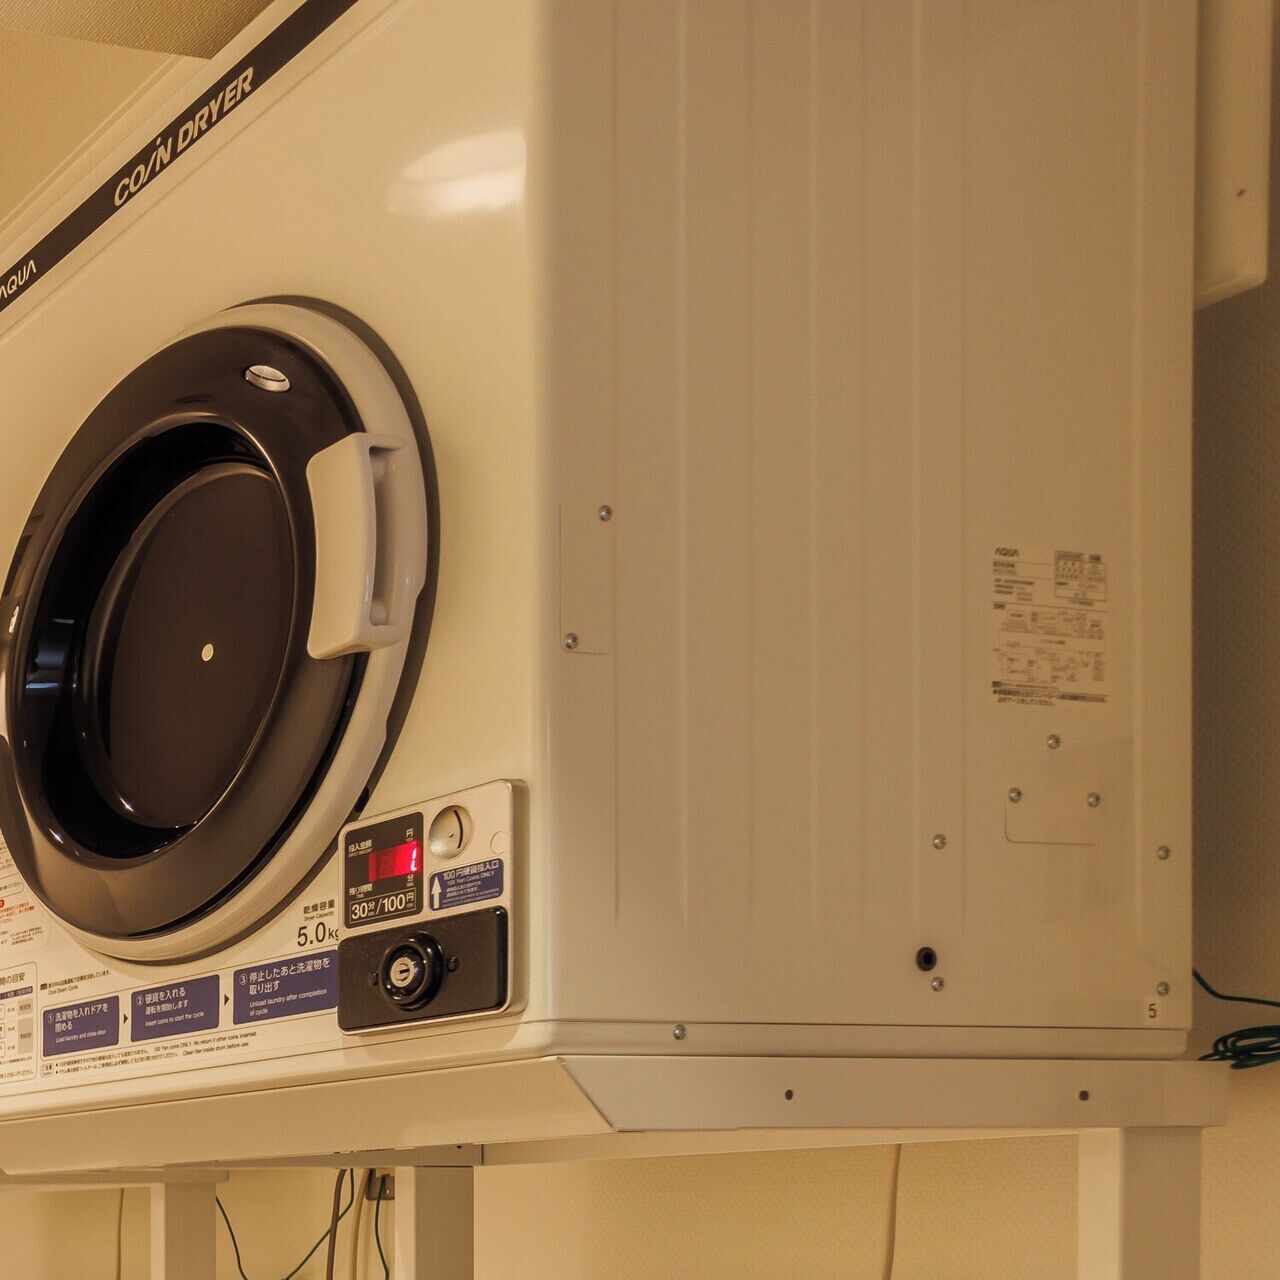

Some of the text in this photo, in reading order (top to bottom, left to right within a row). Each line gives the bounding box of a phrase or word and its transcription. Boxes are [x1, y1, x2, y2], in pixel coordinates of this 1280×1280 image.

[114, 67, 253, 207] COIN DRYER
[994, 547, 1020, 557] AQUA
[249, 980, 281, 995] 取り出す
[286, 993, 298, 1001] after
[298, 988, 328, 1001] completion
[192, 1011, 205, 1020] cycle
[256, 1007, 269, 1017] cycle
[1148, 1003, 1157, 1019] 5
